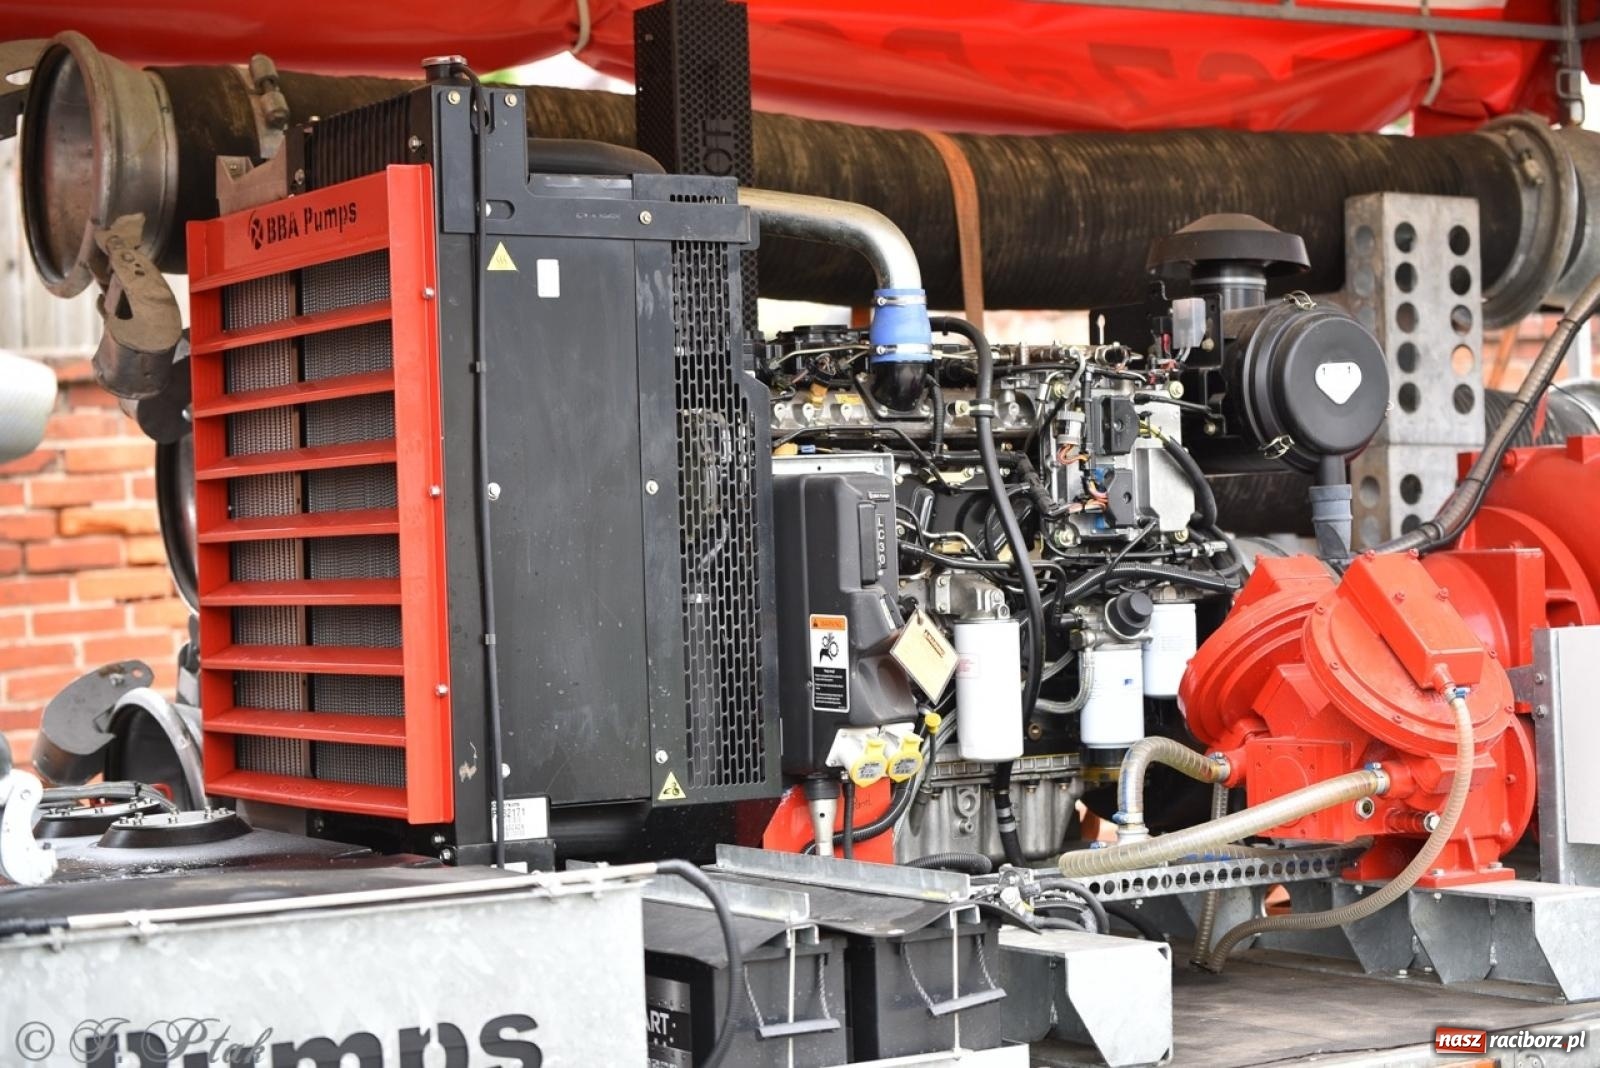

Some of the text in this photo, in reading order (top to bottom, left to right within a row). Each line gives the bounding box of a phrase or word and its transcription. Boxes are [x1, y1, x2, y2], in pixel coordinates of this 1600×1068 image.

[267, 202, 356, 244] BBA Pumps
[646, 1010, 670, 1036] RT
